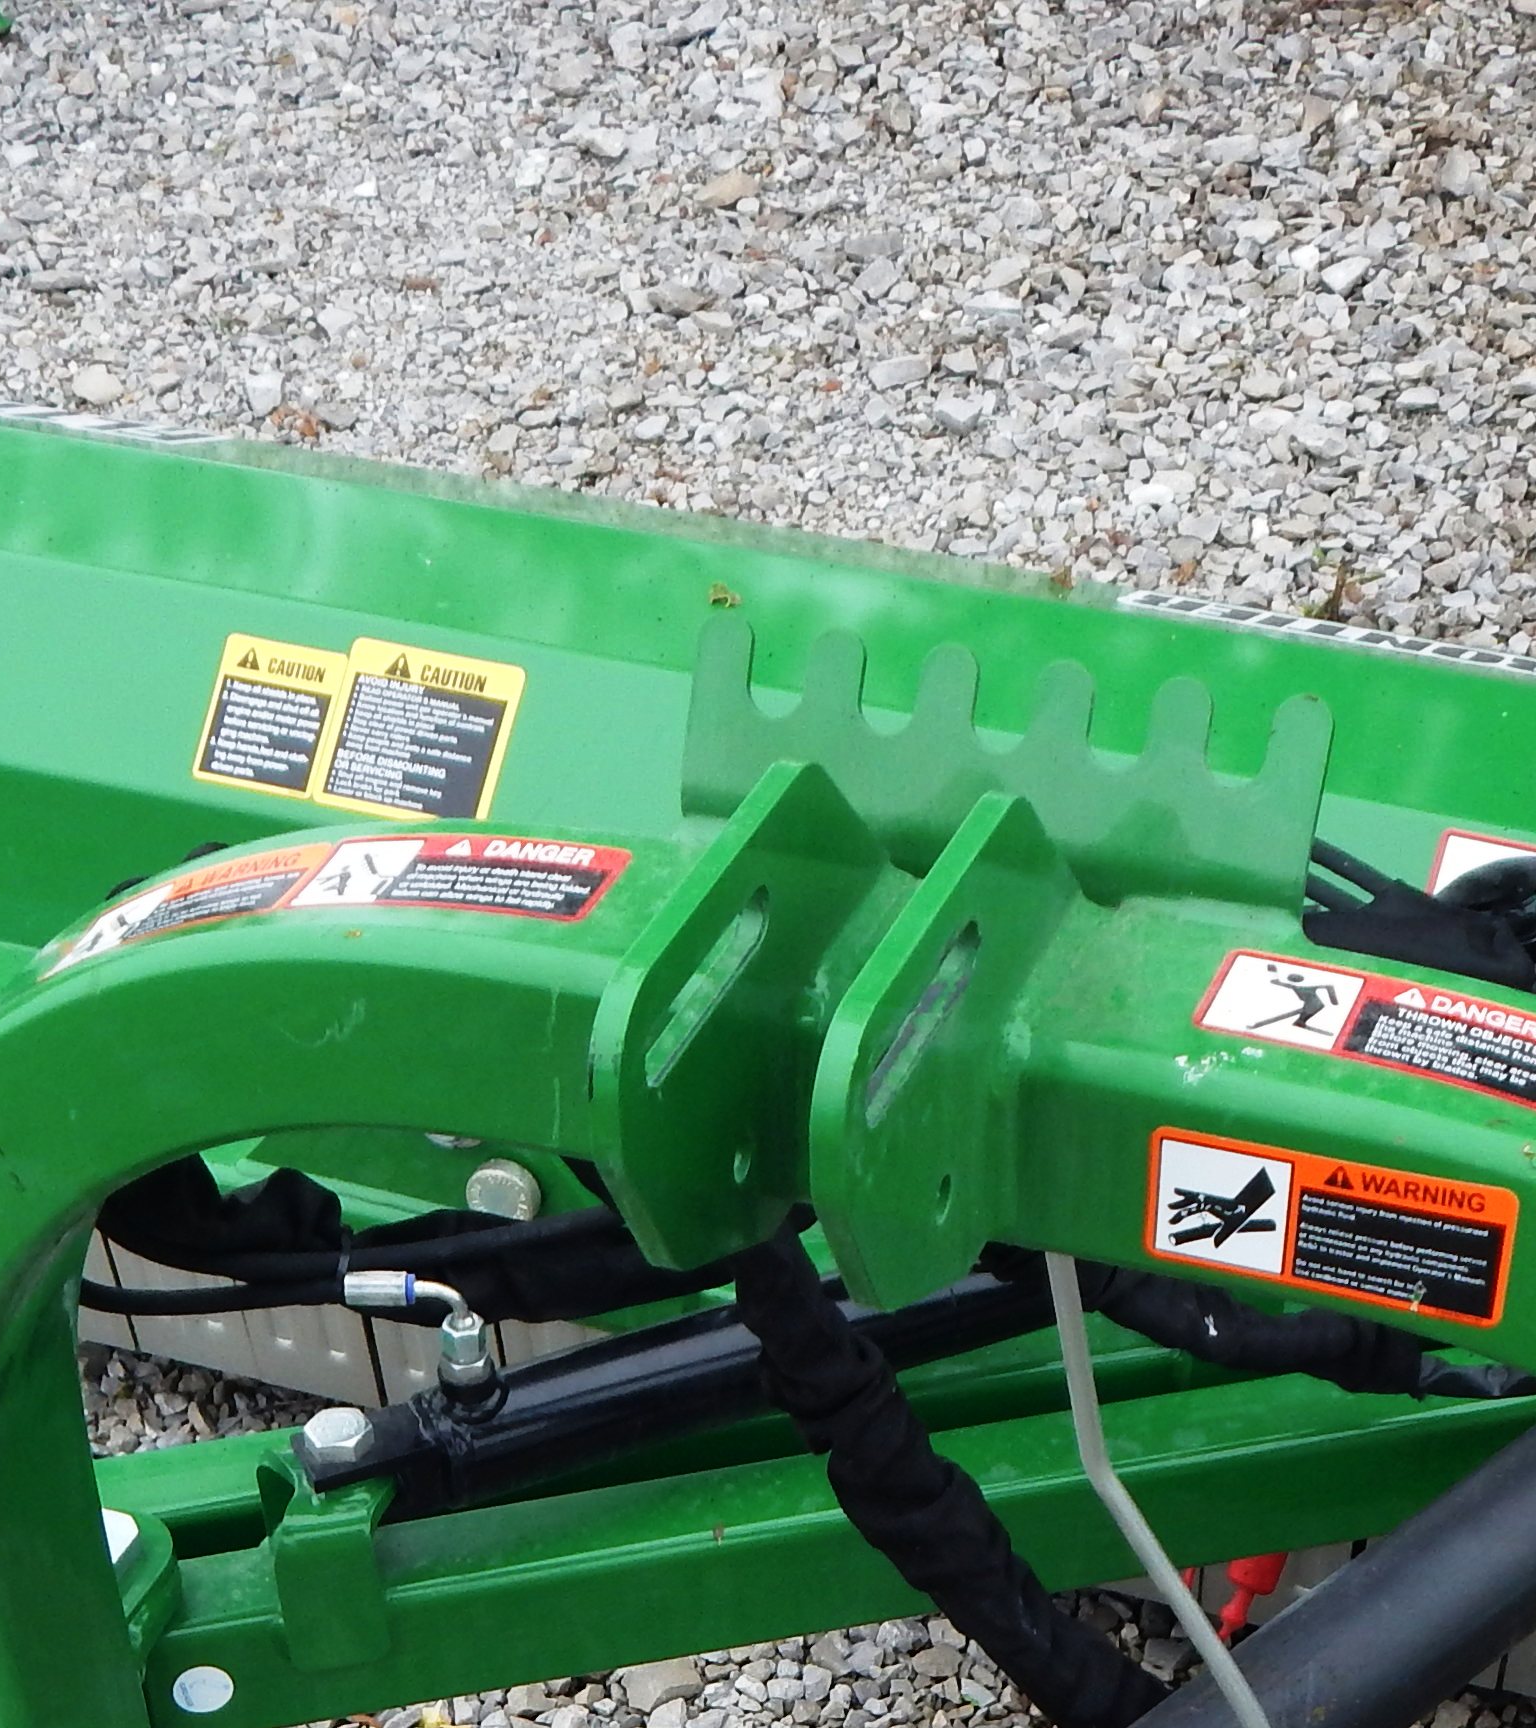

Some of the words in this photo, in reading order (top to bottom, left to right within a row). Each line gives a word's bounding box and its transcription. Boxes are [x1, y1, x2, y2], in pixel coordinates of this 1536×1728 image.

[268, 657, 326, 682] CAUTION
[421, 664, 487, 692] CAUTION
[334, 759, 348, 768] OR
[351, 762, 403, 780] SERVICING
[337, 749, 375, 763] BEFORE
[377, 756, 446, 778] DISMOUNTING
[482, 841, 597, 865] DANGER
[201, 852, 301, 887] WARNING
[1379, 1015, 1411, 1029] Keep
[1426, 1027, 1453, 1040] safe
[1455, 1035, 1509, 1056] distance
[1397, 1008, 1466, 1033] THROWN
[1365, 1043, 1408, 1062] thrown
[1412, 1056, 1428, 1067] by
[1432, 1061, 1478, 1080] blades.
[1368, 1036, 1398, 1050] from
[1401, 1044, 1448, 1064] objects
[1451, 1058, 1477, 1070] that
[1479, 1066, 1506, 1080] may
[1509, 1074, 1526, 1085] be
[1372, 1029, 1414, 1046] Before
[1475, 1056, 1506, 1070] clear
[1361, 1172, 1486, 1213] WARNING
